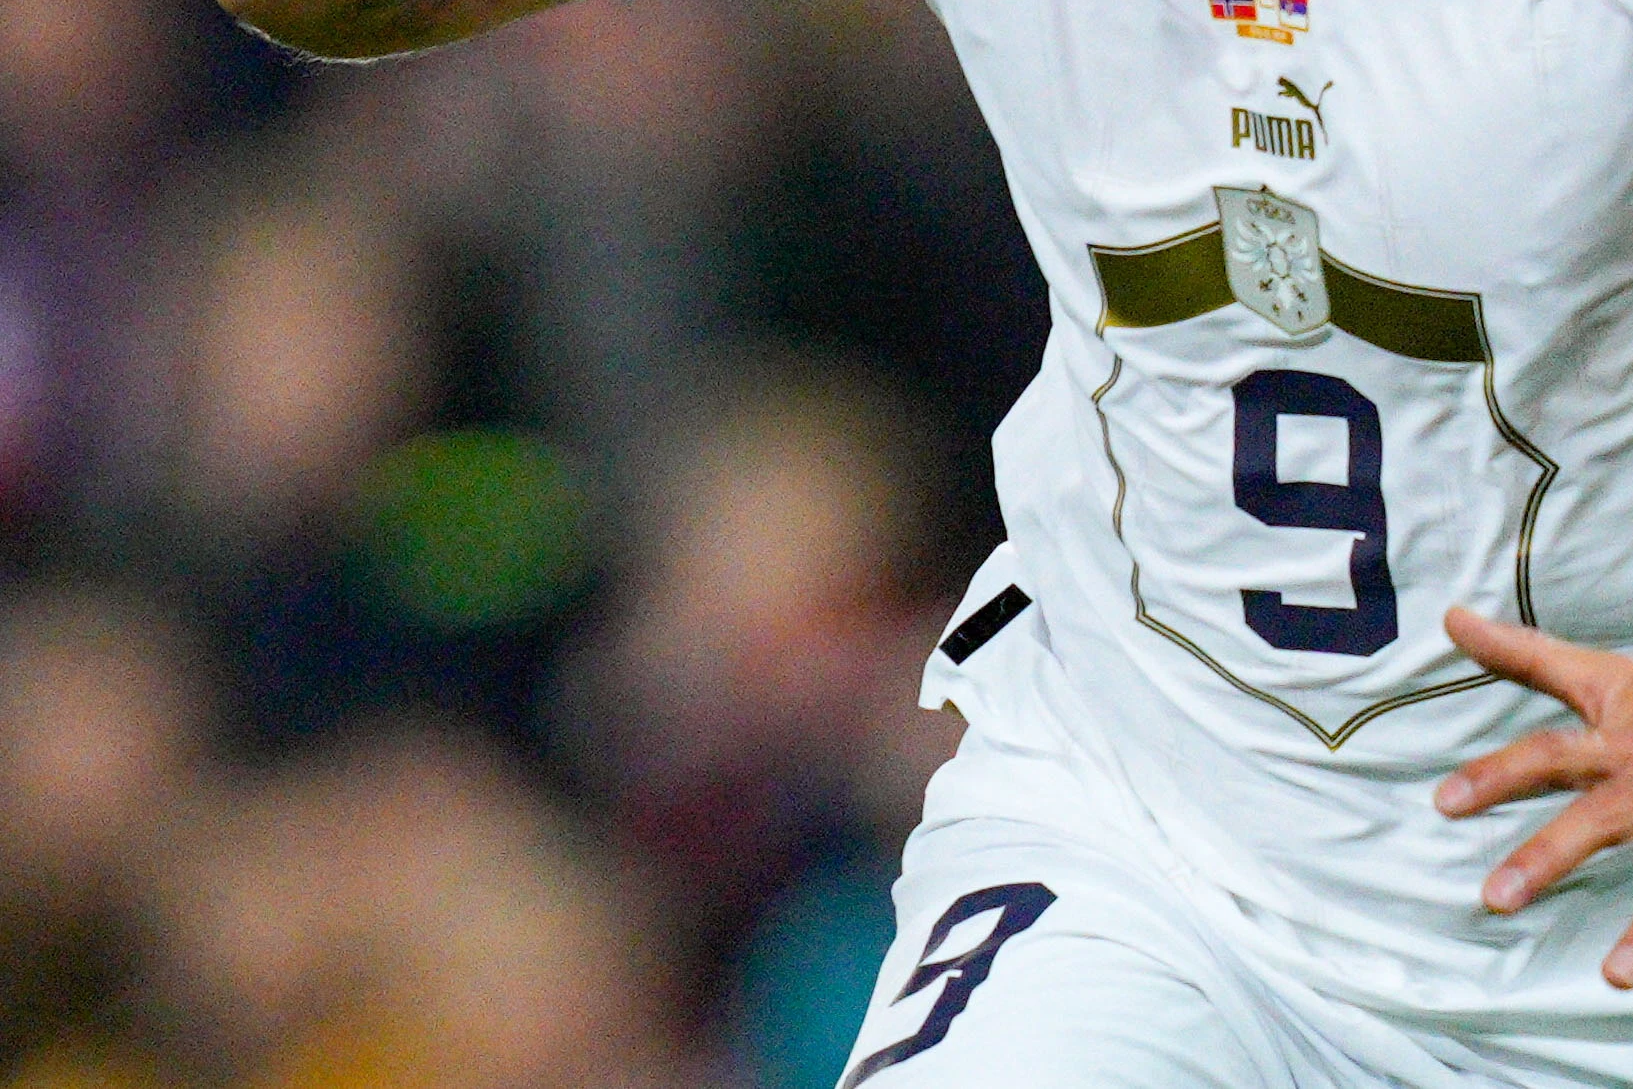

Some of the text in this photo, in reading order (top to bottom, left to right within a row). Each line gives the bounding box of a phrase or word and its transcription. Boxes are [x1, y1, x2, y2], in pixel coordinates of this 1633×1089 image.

[1231, 108, 1315, 160] PUMA
[1232, 370, 1398, 657] 9
[841, 882, 1058, 1089] 9
